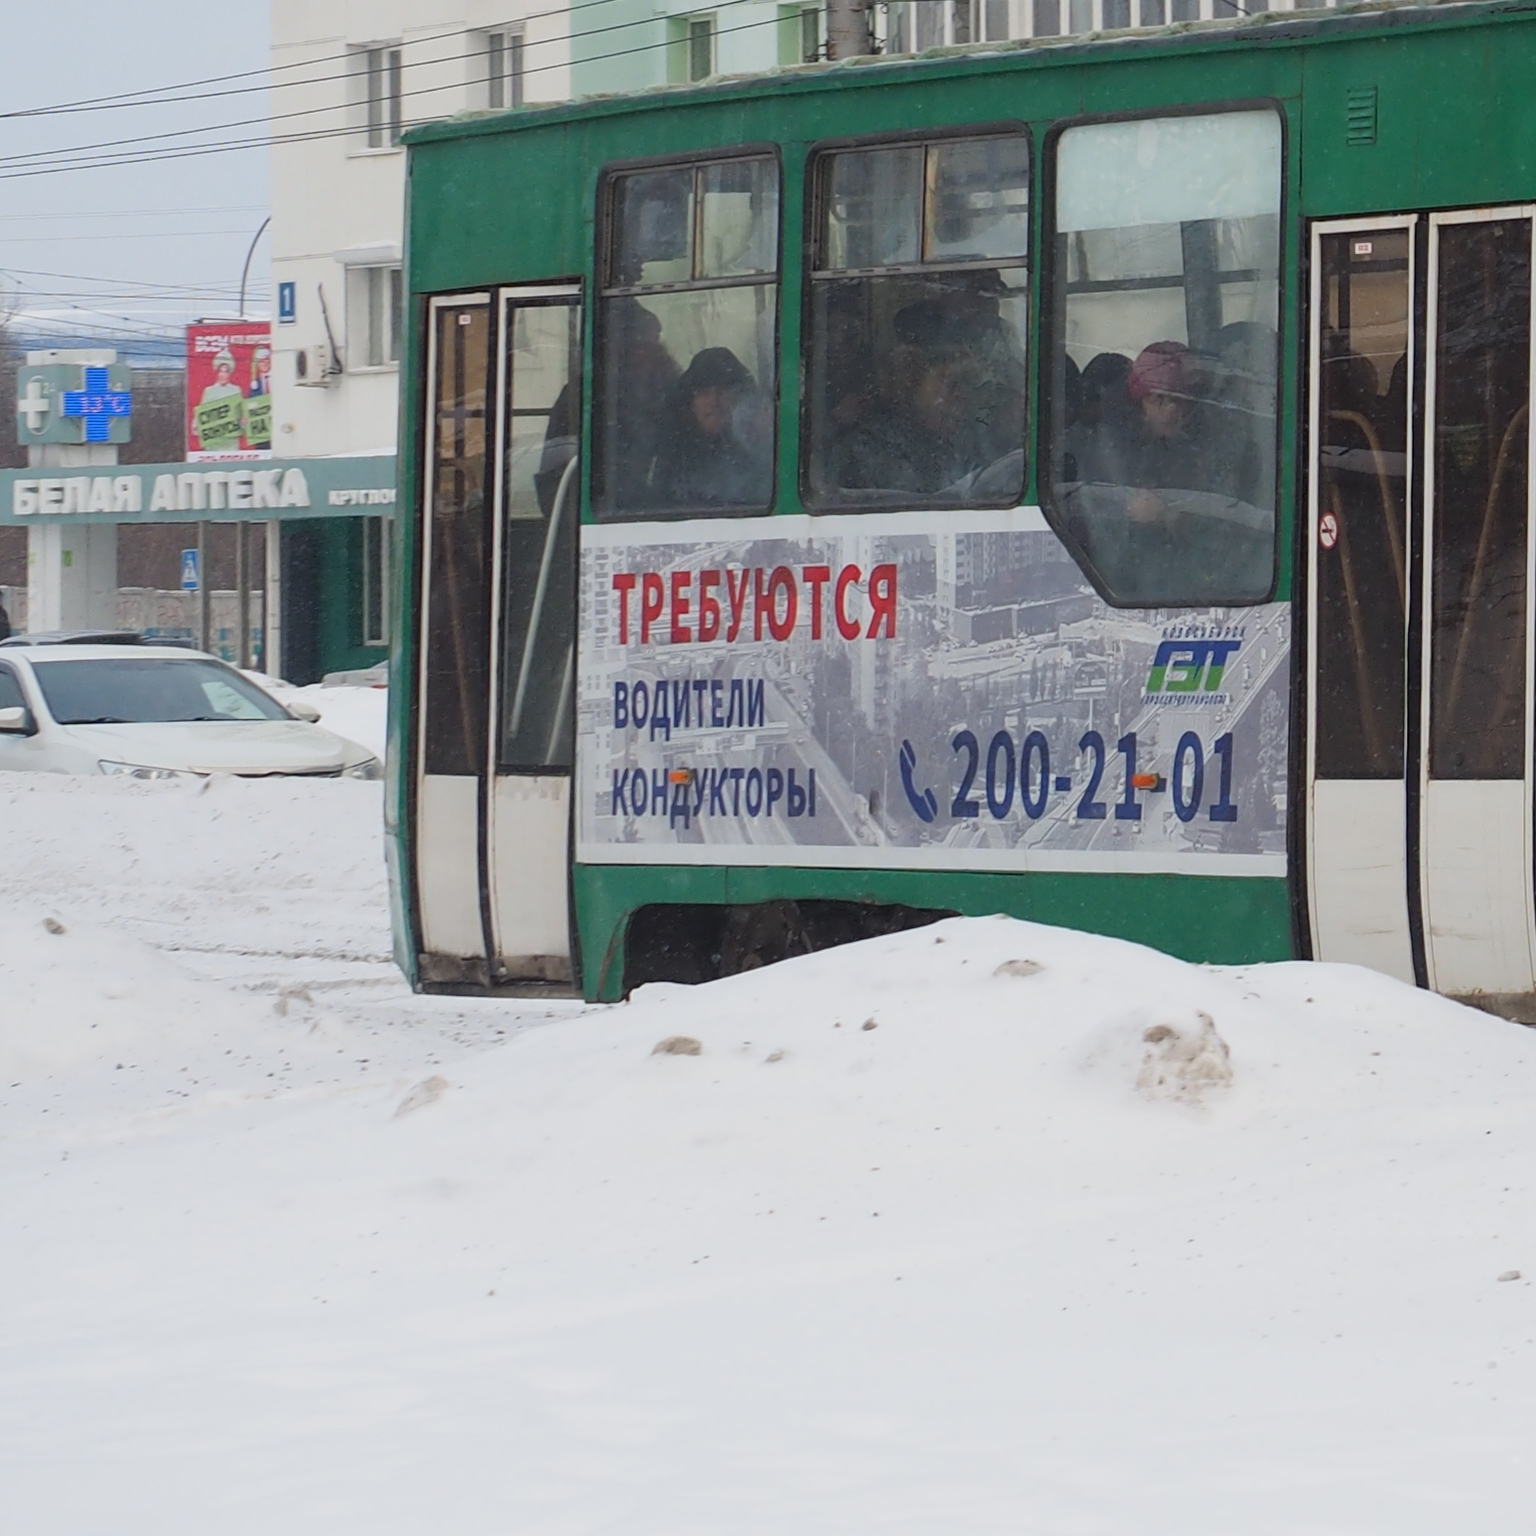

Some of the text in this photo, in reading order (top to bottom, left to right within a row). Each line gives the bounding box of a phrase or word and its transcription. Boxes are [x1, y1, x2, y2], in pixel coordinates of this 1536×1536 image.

[283, 286, 291, 312] 1
[13, 467, 311, 515] БЕЛАЯ АПТЕКА
[612, 564, 898, 644] ТРЕБУЮТСЯ
[1147, 641, 1242, 692] ГЭТ
[614, 679, 765, 741] ВОДИТЕЛИ
[612, 767, 816, 828] КОНДУКТОРЫ
[951, 730, 1238, 822] 200-21-01
